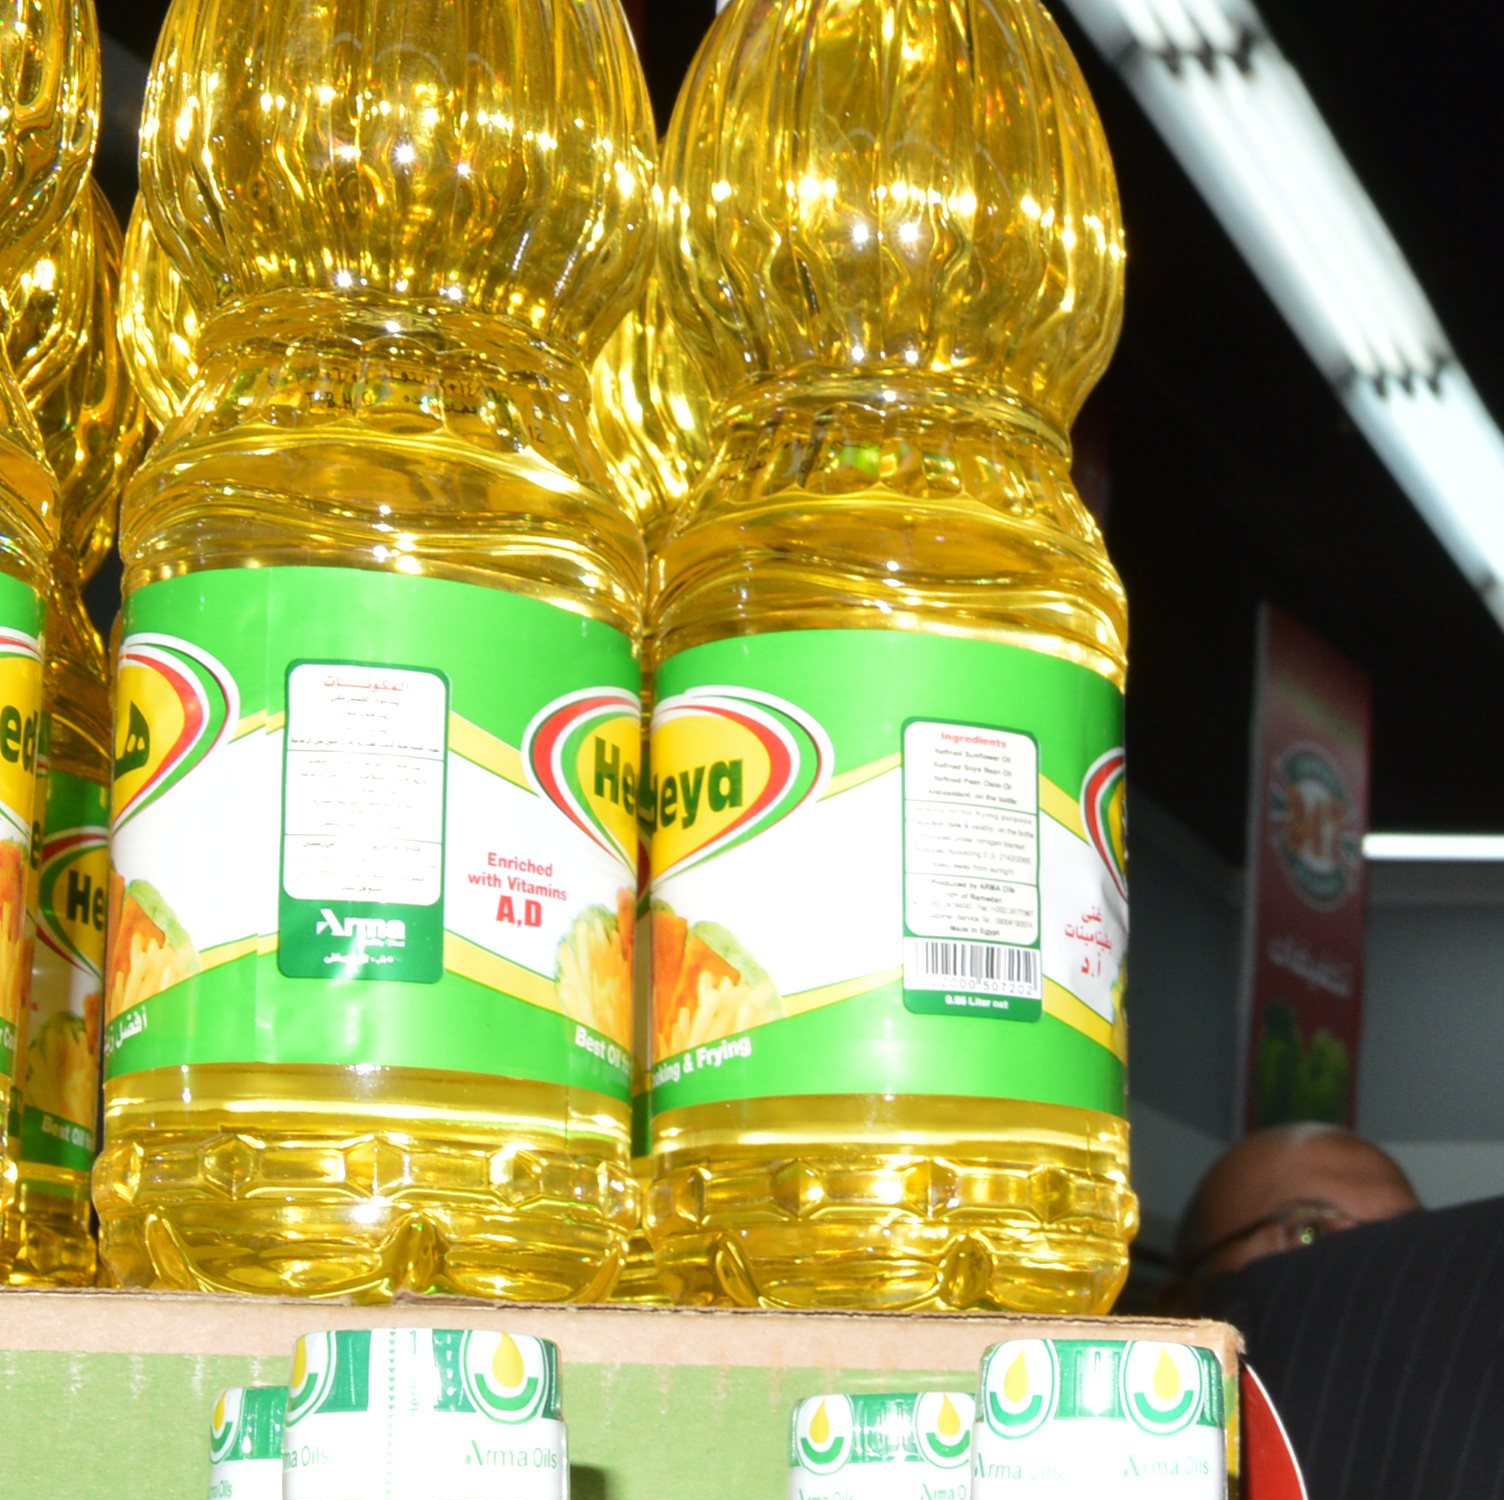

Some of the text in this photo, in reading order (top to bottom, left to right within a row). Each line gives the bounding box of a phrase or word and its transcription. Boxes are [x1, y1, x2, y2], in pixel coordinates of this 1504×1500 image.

[941, 731, 1007, 749] Ingredients
[487, 851, 553, 878] Enriched
[467, 871, 568, 901] with Vitamins
[315, 908, 406, 940] Arma
[495, 894, 543, 928] A,D
[574, 1024, 606, 1060] Best
[682, 1052, 695, 1074] &
[695, 1036, 752, 1069] Frying
[465, 1439, 558, 1470] Arma Oils
